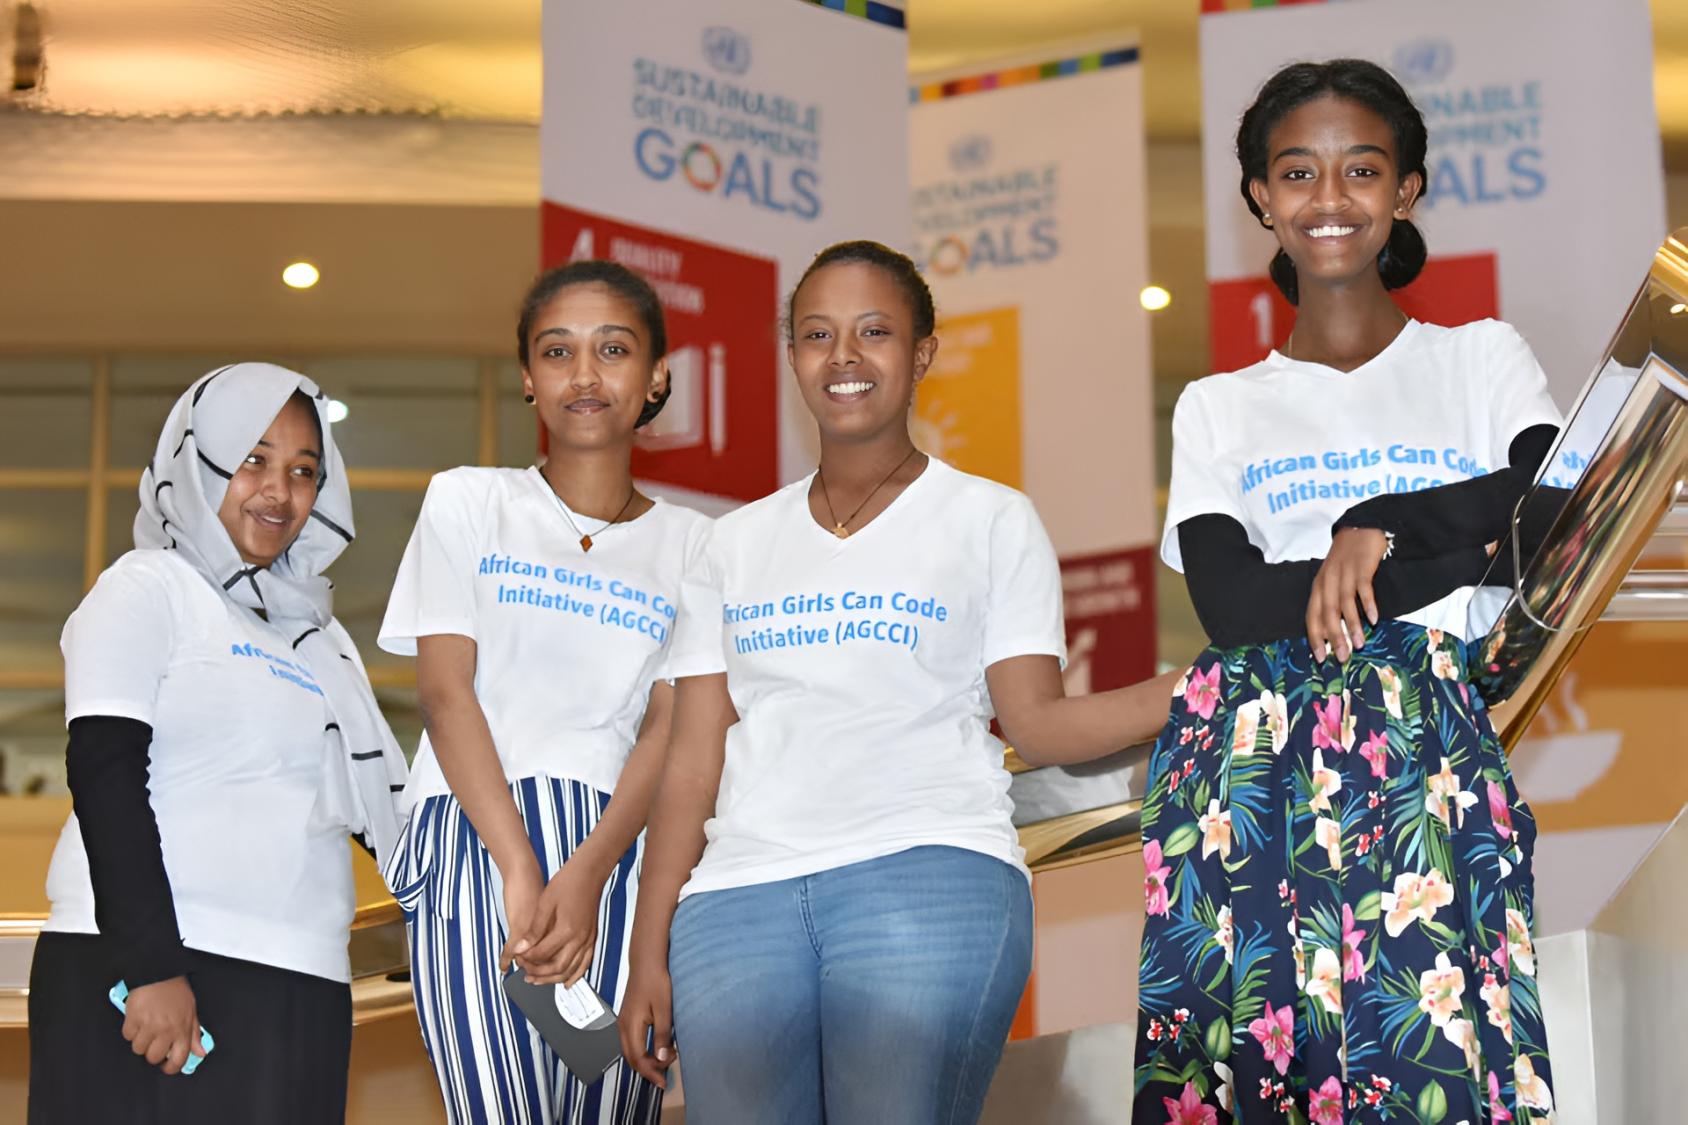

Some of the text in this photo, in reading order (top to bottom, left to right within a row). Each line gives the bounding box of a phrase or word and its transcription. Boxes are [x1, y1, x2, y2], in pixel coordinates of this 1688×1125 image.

[632, 57, 820, 133] SUSTAINABLE
[634, 127, 822, 220] GOALS
[1426, 147, 1547, 208] ALS
[1322, 448, 1382, 470] Girls
[1388, 444, 1436, 465] Can
[1267, 478, 1380, 514] Initiative
[479, 554, 677, 619] African Girls Can Co
[498, 585, 666, 644] Initiative (AGCCI
[782, 593, 835, 614] Girls
[841, 591, 883, 610] Can
[891, 592, 948, 622] Code
[735, 620, 919, 654] Initiative (AGCCI)
